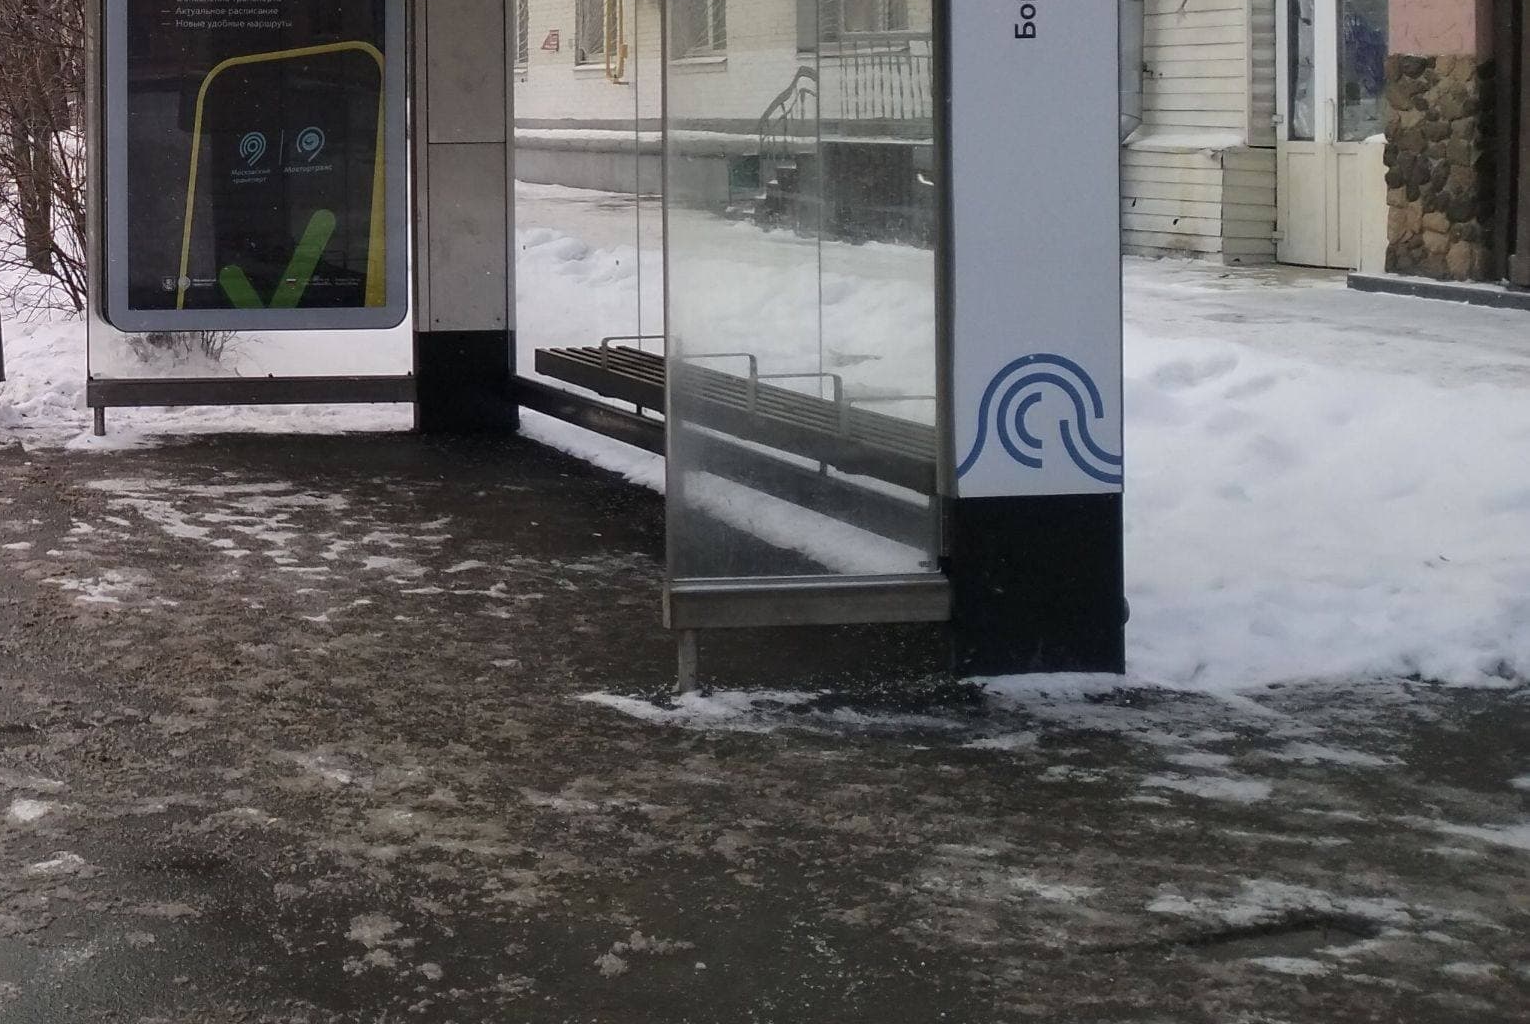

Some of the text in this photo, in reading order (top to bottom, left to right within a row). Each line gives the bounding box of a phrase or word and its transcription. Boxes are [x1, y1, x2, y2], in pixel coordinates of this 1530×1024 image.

[175, 6, 279, 16] Актуальное расписание
[175, 19, 206, 27] Новые
[207, 19, 246, 29] удобные
